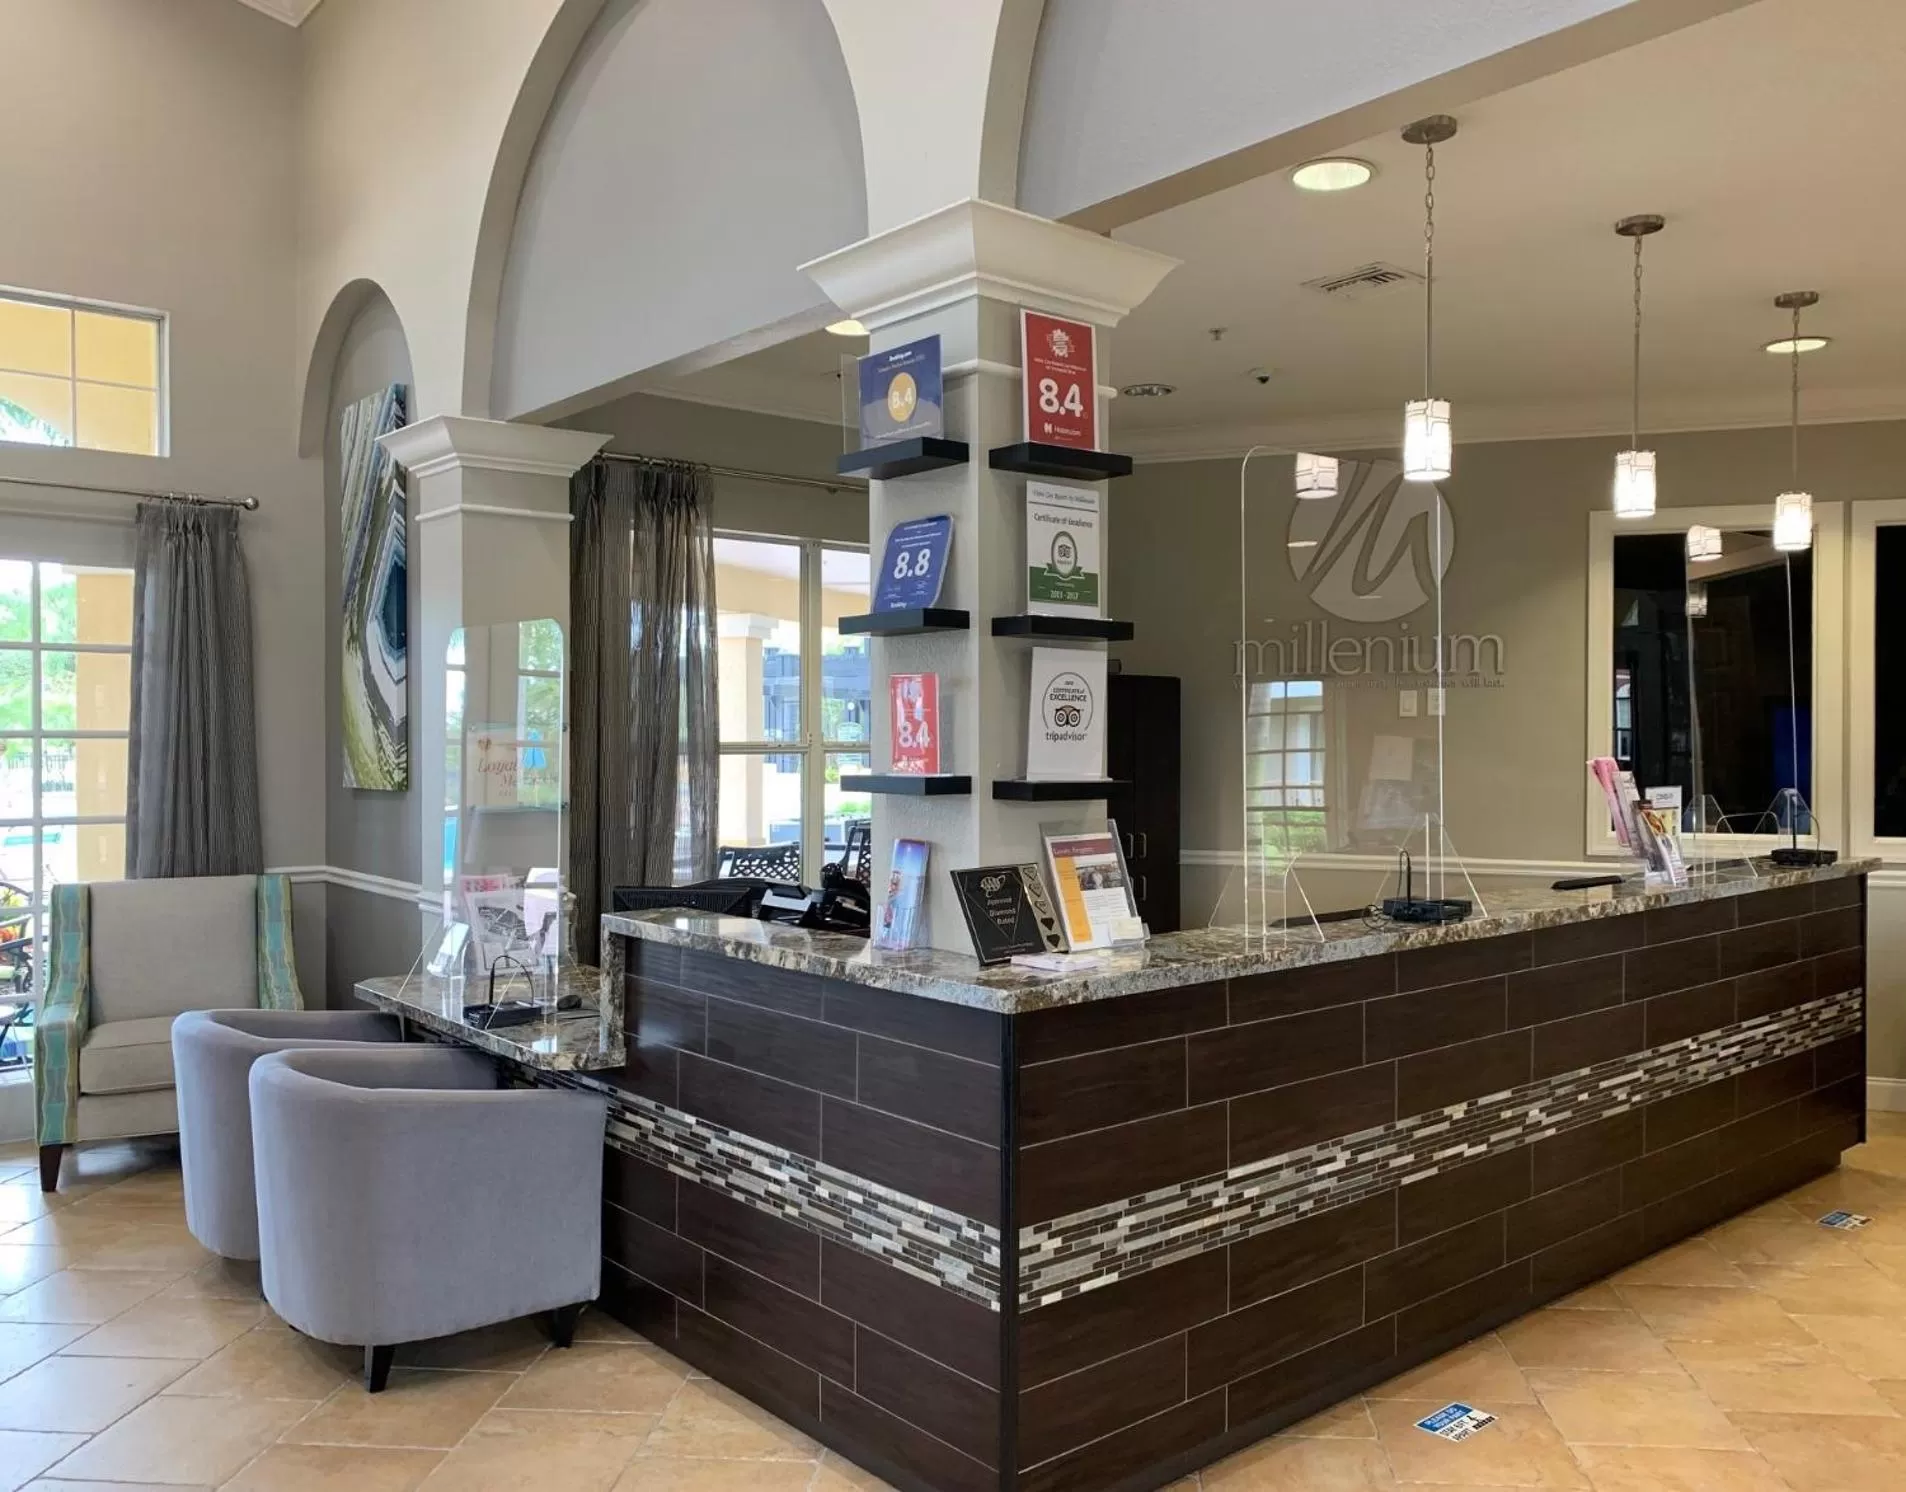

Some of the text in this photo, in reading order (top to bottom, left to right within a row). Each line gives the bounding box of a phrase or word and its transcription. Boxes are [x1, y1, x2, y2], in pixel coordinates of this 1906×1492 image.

[892, 387, 913, 409] 8.4
[1039, 378, 1083, 417] 8.4
[893, 548, 931, 579] 8.8
[1233, 620, 1504, 677] millenium
[1050, 693, 1088, 702] EXCELLENCE
[899, 721, 930, 748] 8.4
[1045, 731, 1086, 743] tripadvisor
